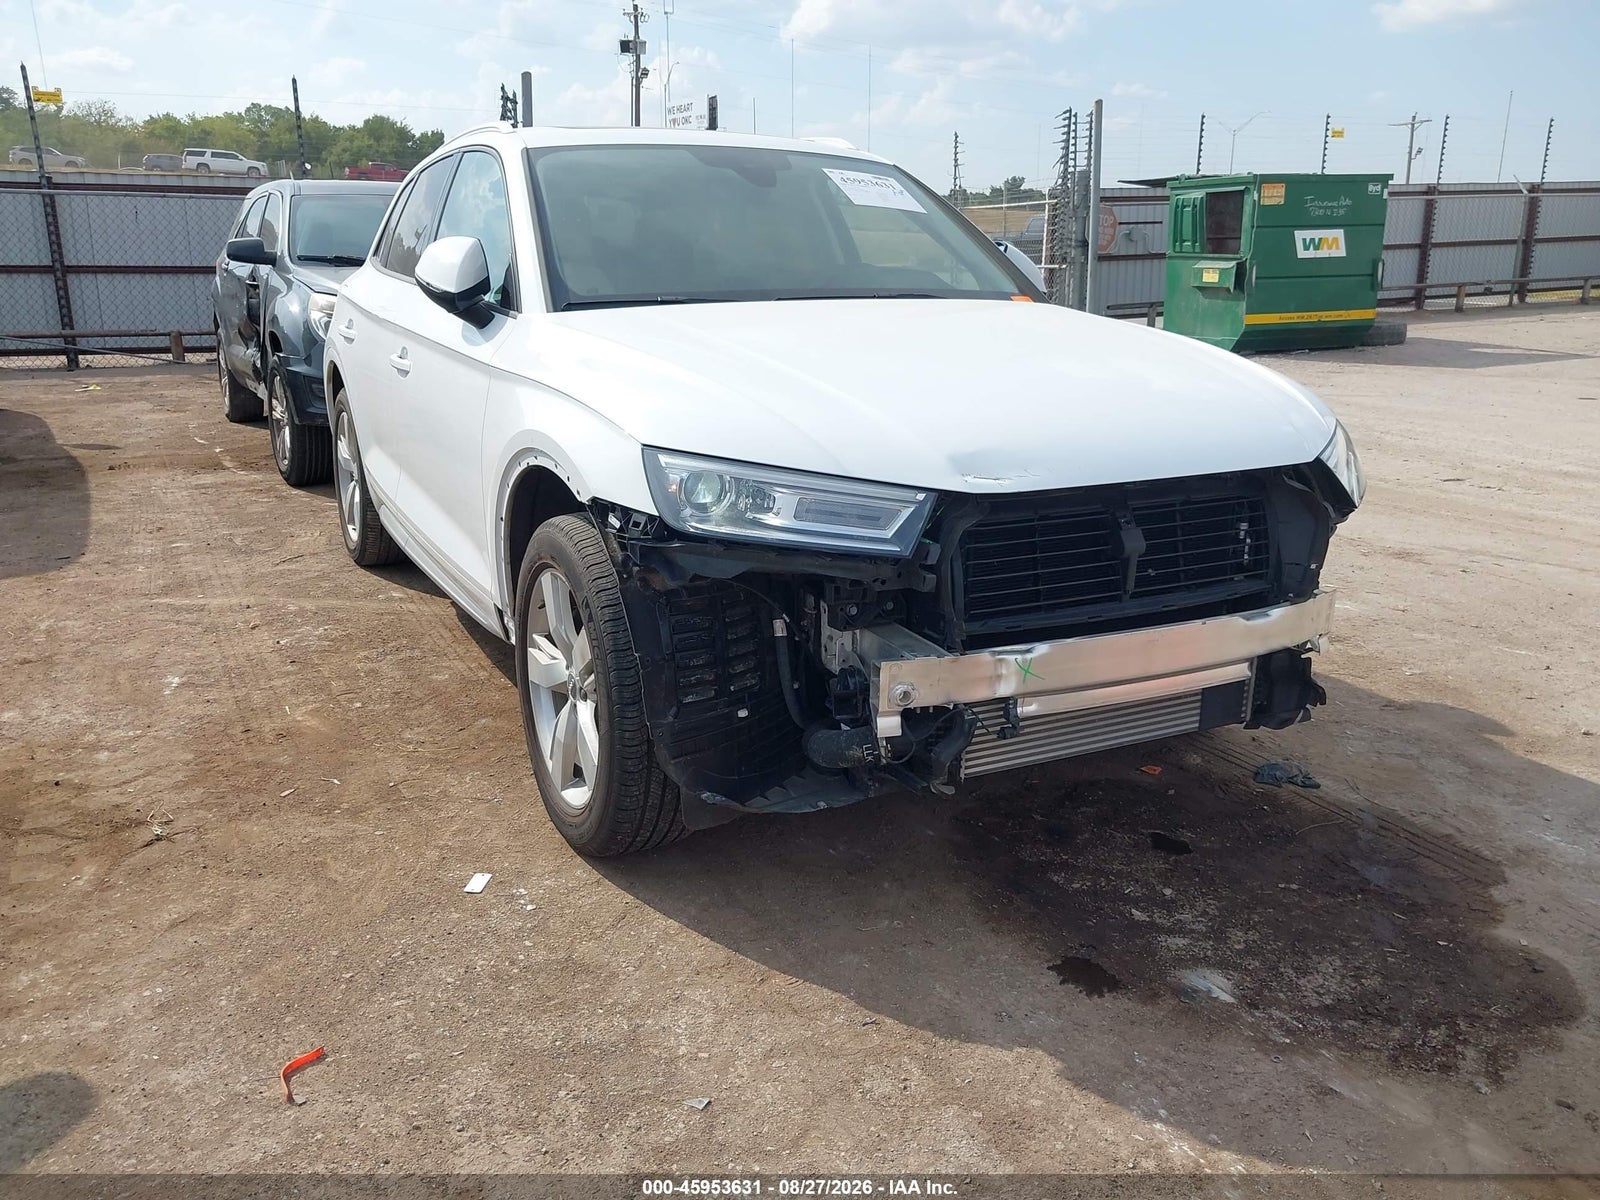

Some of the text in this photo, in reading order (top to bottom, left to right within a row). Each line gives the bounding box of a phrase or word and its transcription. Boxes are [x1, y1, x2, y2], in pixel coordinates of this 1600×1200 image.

[667, 102, 693, 115] WE HEART
[681, 115, 692, 126] OKC
[1098, 214, 1115, 225] TOP
[1301, 236, 1340, 251] WM
